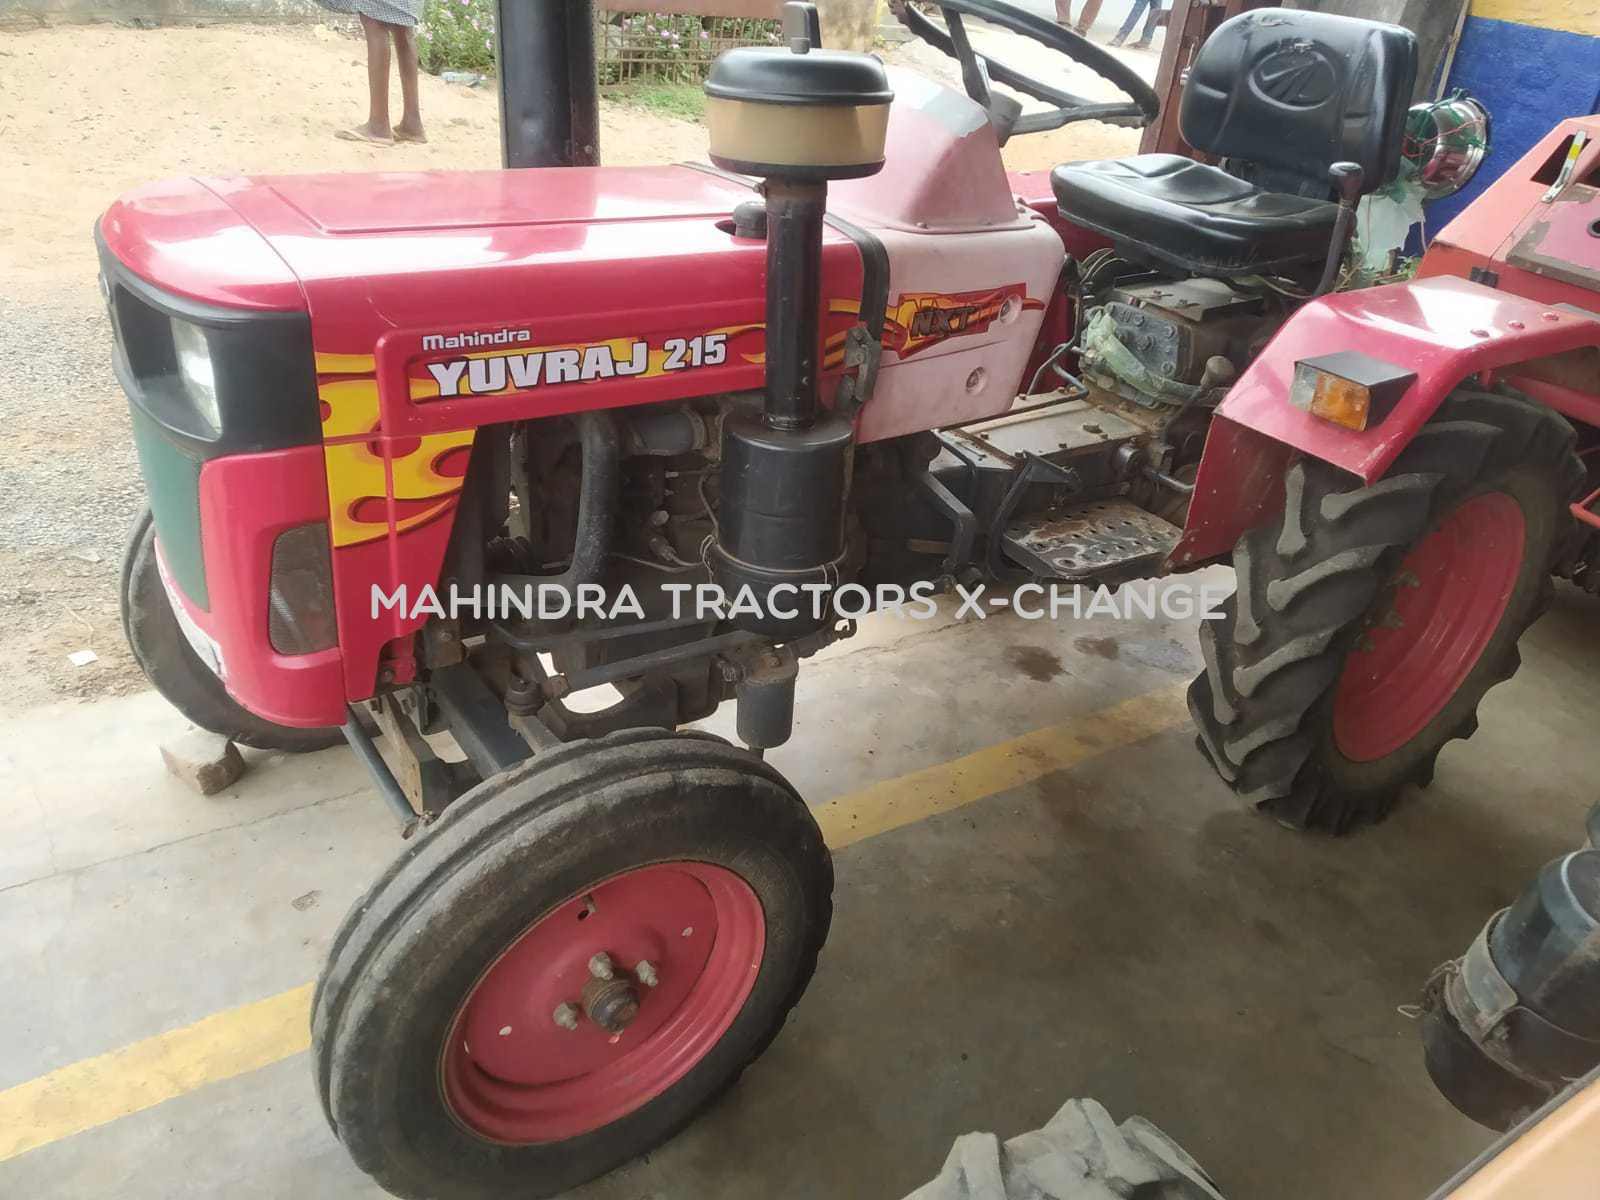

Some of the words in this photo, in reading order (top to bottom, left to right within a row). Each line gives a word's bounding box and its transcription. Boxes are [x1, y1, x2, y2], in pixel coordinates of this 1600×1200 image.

[911, 305, 977, 337] NXT
[422, 328, 531, 350] Mahindra
[427, 341, 649, 397] YUVRAJ
[663, 333, 728, 371] 215
